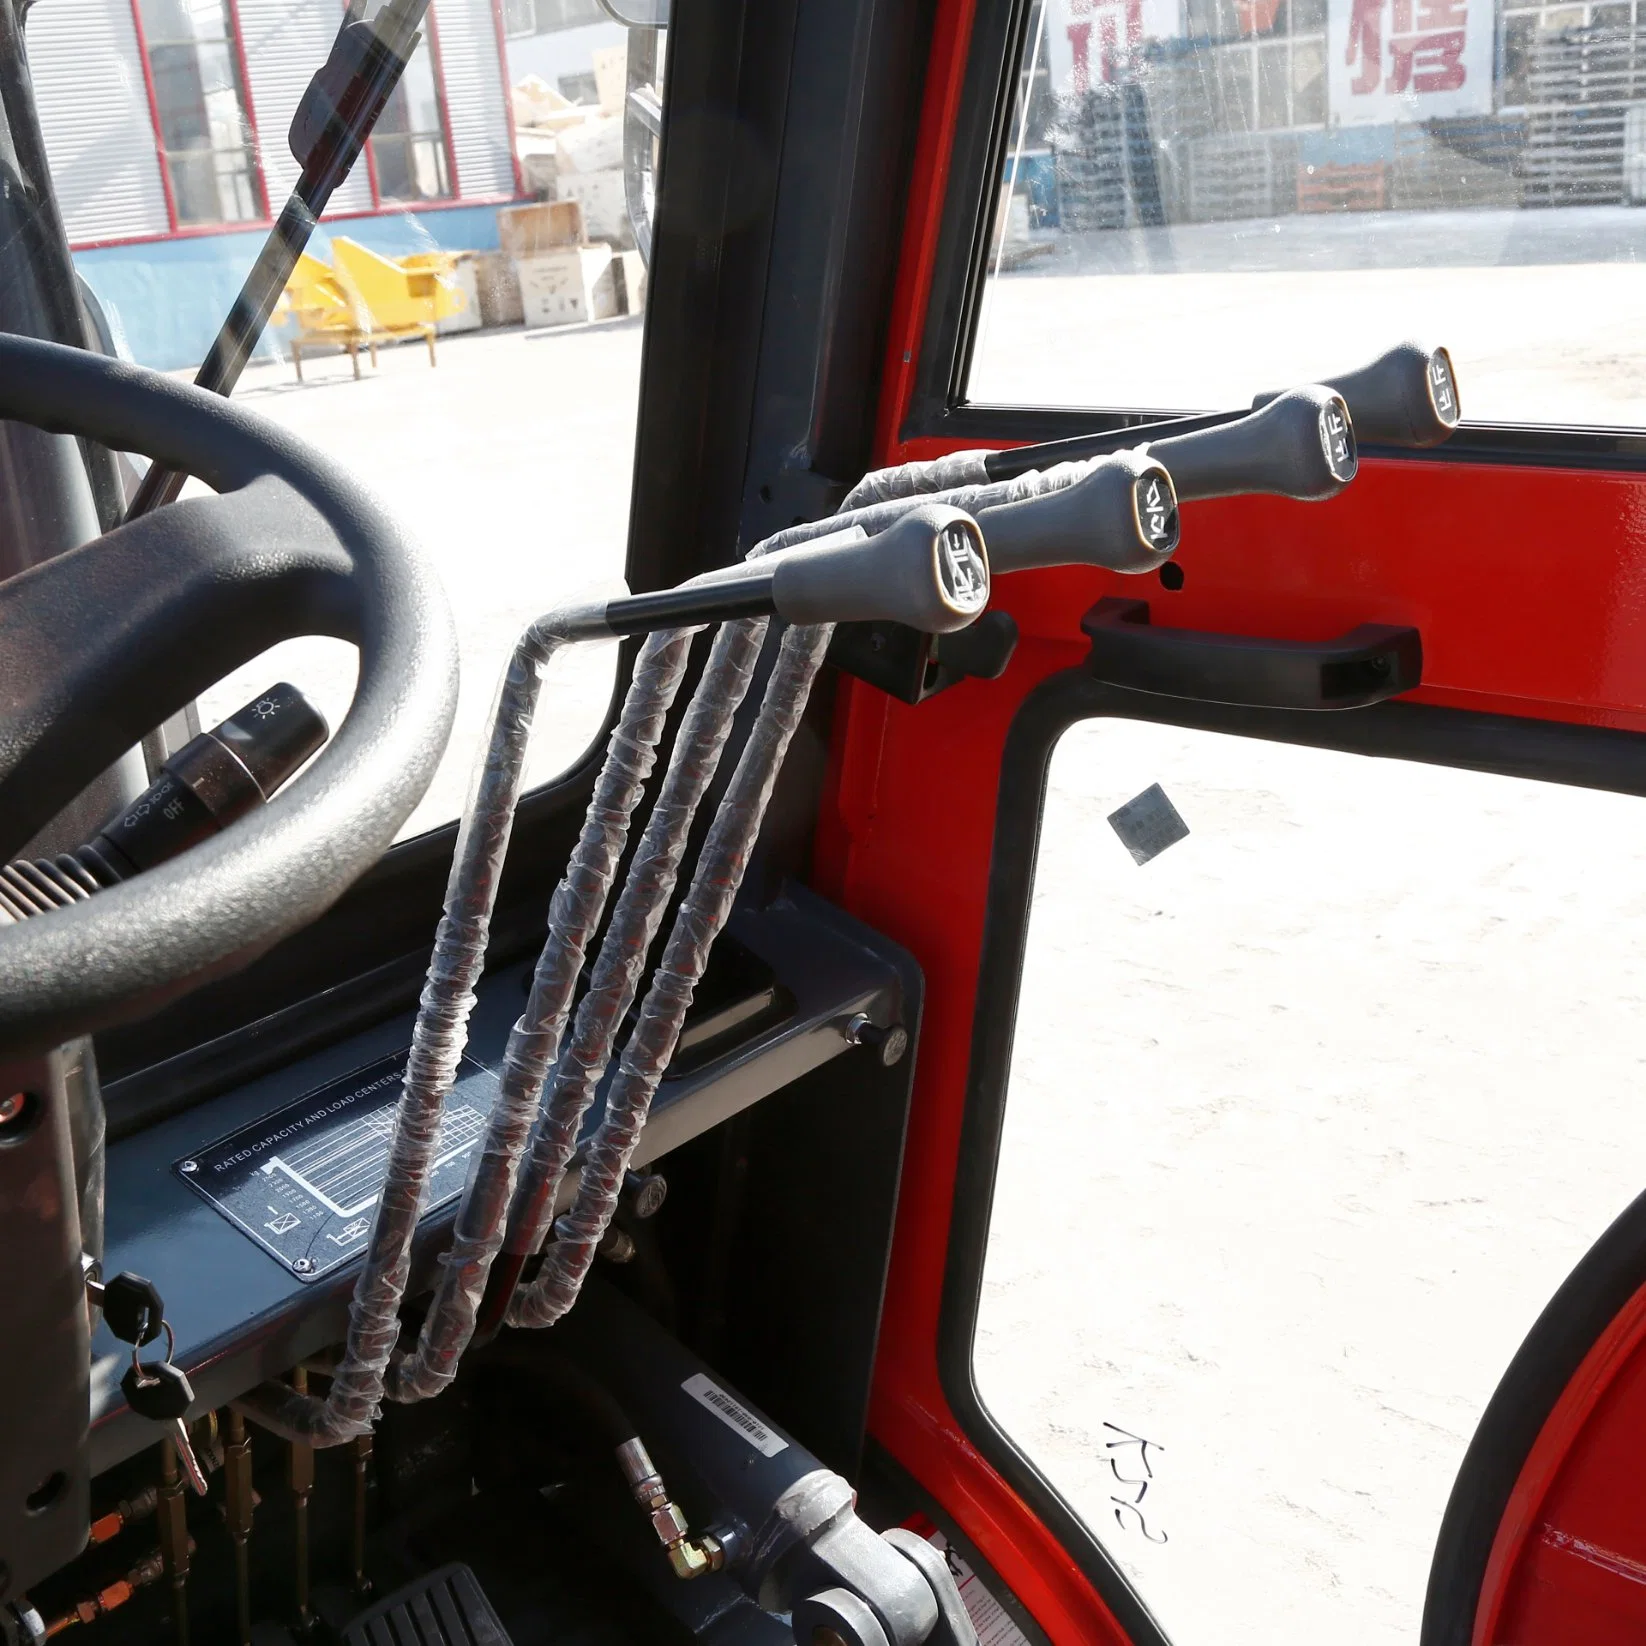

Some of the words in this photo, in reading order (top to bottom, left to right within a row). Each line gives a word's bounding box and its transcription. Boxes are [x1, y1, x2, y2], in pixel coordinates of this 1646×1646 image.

[163, 797, 185, 820] OFF
[214, 1148, 252, 1172] RATED
[252, 1120, 305, 1152] CAPACITY
[304, 1109, 327, 1126] AND
[327, 1094, 355, 1113] LOAD
[355, 1072, 402, 1099] CENTERS
